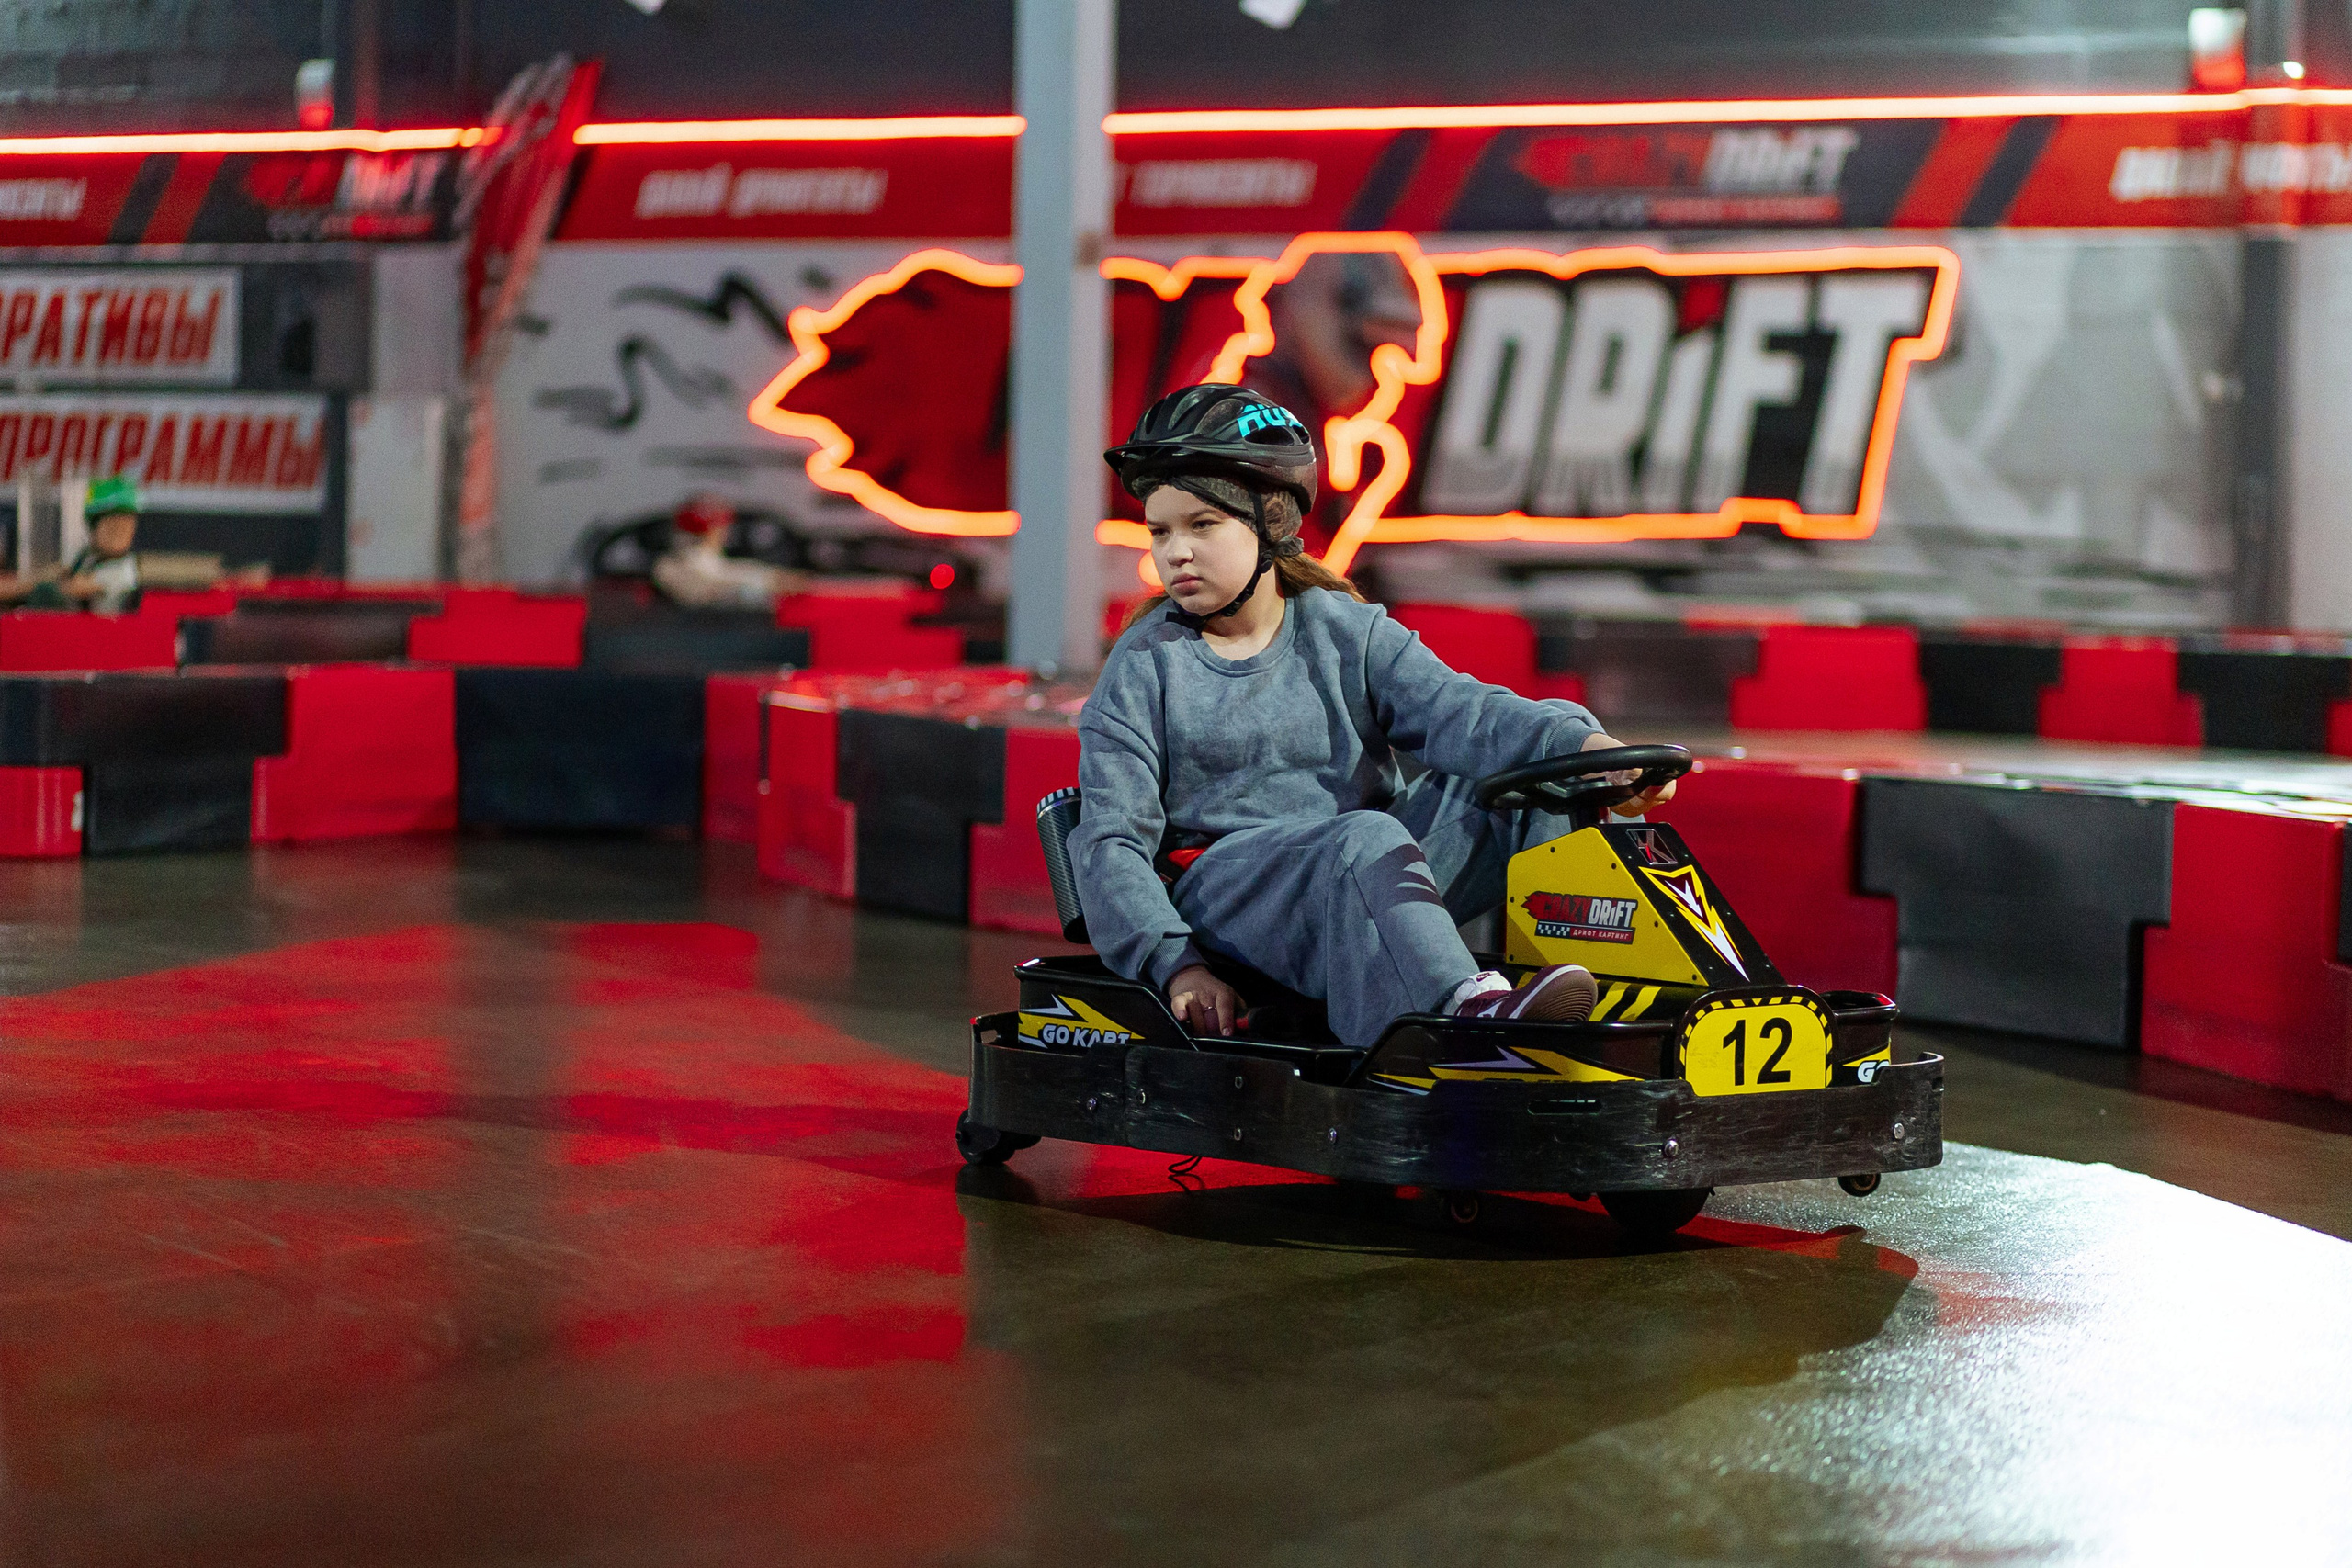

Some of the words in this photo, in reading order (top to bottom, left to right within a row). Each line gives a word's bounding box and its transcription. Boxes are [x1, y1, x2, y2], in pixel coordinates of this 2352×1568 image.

[0, 289, 223, 365] РАТИВЫ
[1572, 929, 1596, 937] ДРИФТ
[1598, 931, 1630, 940] КАРТИНГ
[1042, 1024, 1070, 1045] GO
[1723, 1017, 1792, 1086] 12
